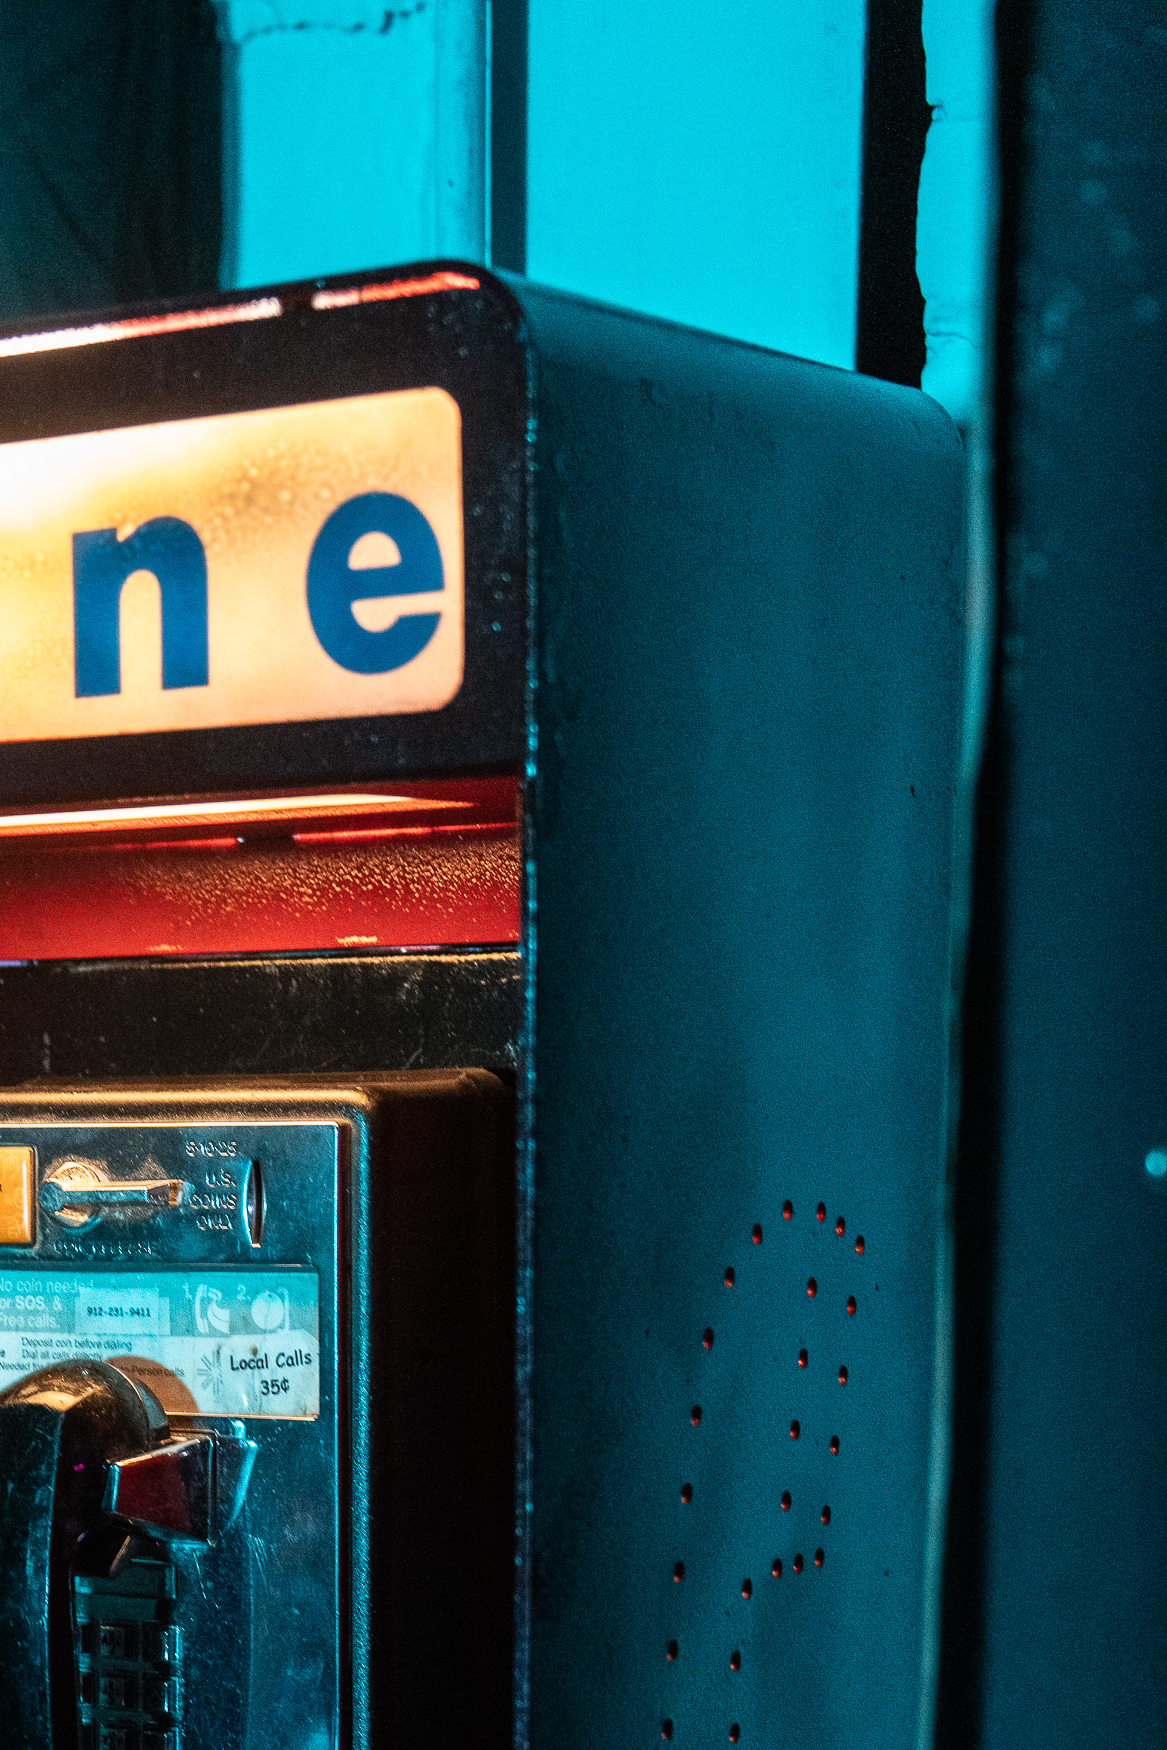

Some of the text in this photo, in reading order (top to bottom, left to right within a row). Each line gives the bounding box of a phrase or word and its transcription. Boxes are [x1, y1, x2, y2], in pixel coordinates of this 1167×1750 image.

[17, 1278, 43, 1293] coin
[53, 1297, 62, 1310] &
[87, 1306, 151, 1317] 912-231-9411
[22, 1337, 52, 1348] Deposit
[74, 1337, 102, 1349] before
[103, 1339, 132, 1352] dialing
[22, 1349, 38, 1359] Dial
[40, 1350, 50, 1359] all
[52, 1350, 70, 1360] calls
[230, 1349, 312, 1371] Local Calls
[261, 1377, 290, 1396] 35¢
